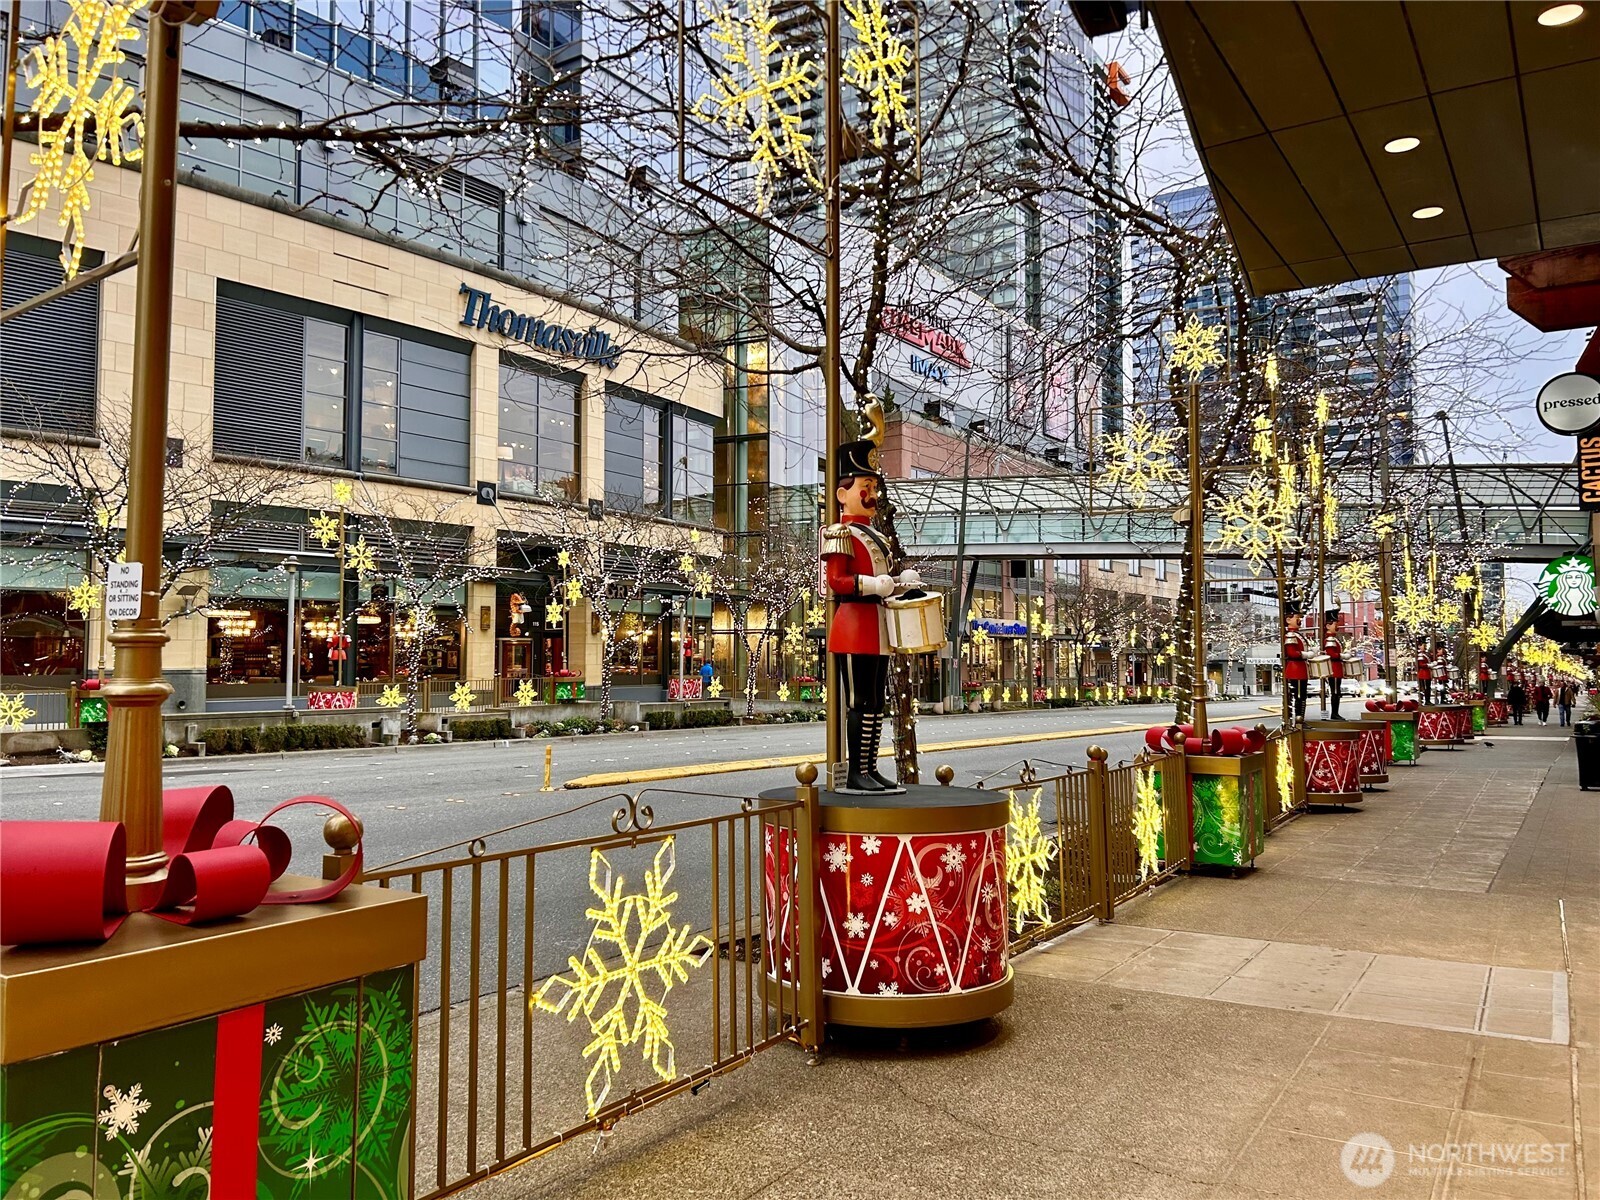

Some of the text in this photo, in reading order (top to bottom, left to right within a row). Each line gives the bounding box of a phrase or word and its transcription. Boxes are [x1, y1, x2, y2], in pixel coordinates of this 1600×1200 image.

[459, 282, 620, 369] Thomasville
[1543, 393, 1600, 412] pressed
[1581, 437, 1600, 503] CACTUS
[120, 566, 129, 574] NO
[110, 580, 138, 588] STANDING
[108, 594, 139, 602] OR SITTING
[108, 608, 137, 616] ON DECOR
